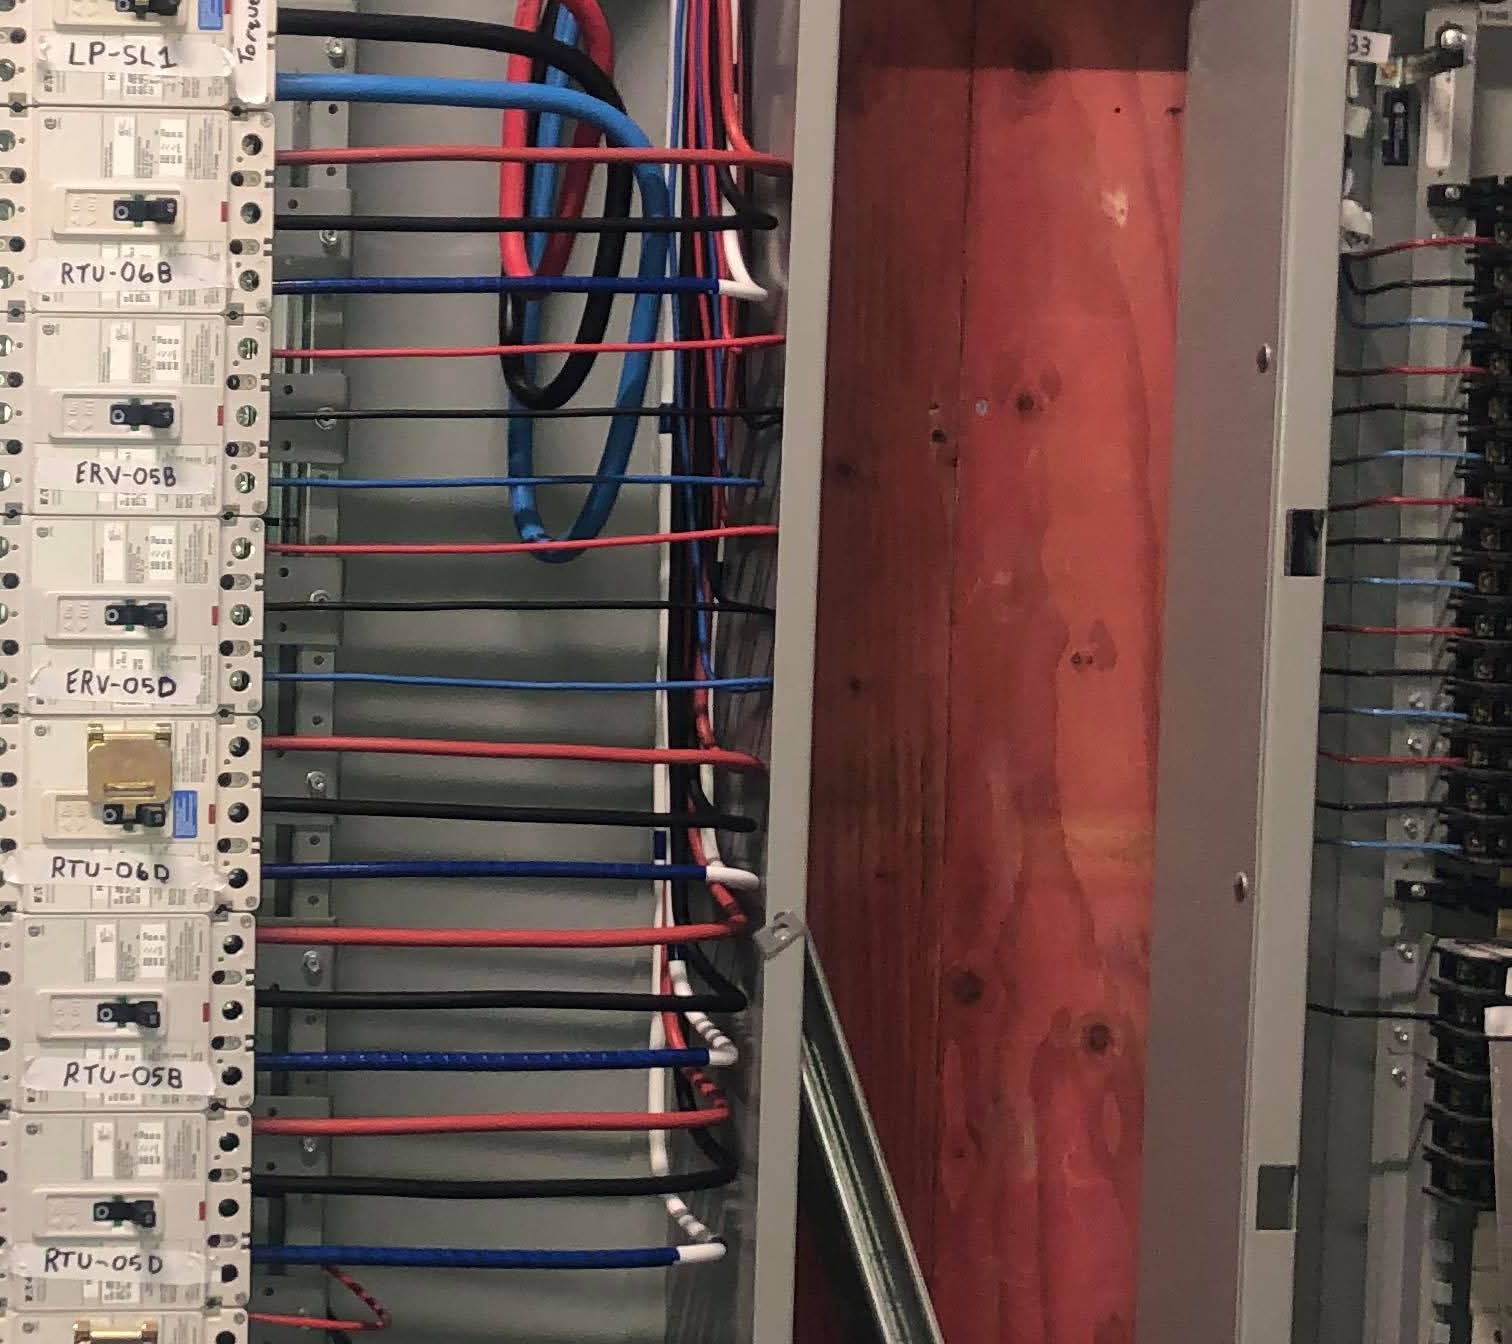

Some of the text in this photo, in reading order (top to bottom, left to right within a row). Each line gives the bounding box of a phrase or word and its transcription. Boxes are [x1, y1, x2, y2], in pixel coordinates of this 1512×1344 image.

[68, 41, 178, 68] LP-SL1
[61, 260, 173, 285] RTU-06B
[75, 461, 177, 487] ERV-05B
[66, 668, 177, 698] ERV-05D
[51, 856, 170, 883] RTU-06D
[63, 1061, 183, 1089] RTU-05B
[44, 1247, 163, 1274] RTU-05D
